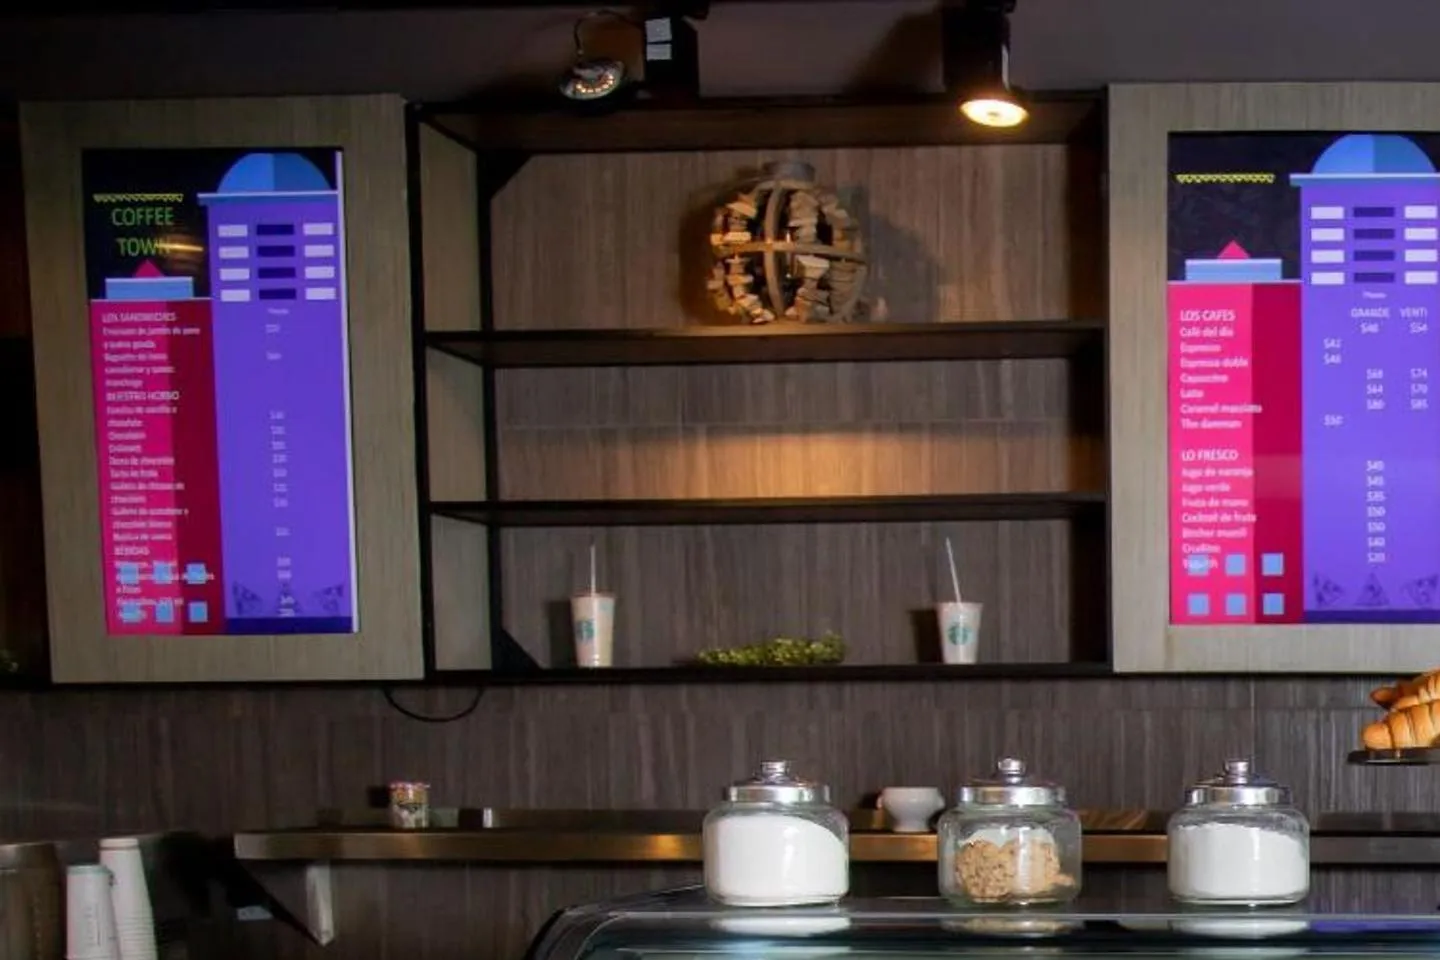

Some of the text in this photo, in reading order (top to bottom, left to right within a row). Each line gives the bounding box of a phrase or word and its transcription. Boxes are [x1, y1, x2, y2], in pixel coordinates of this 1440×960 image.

[112, 207, 174, 226] COFFEE
[115, 237, 170, 257] TOWN
[1198, 448, 1239, 461] FRESCO
